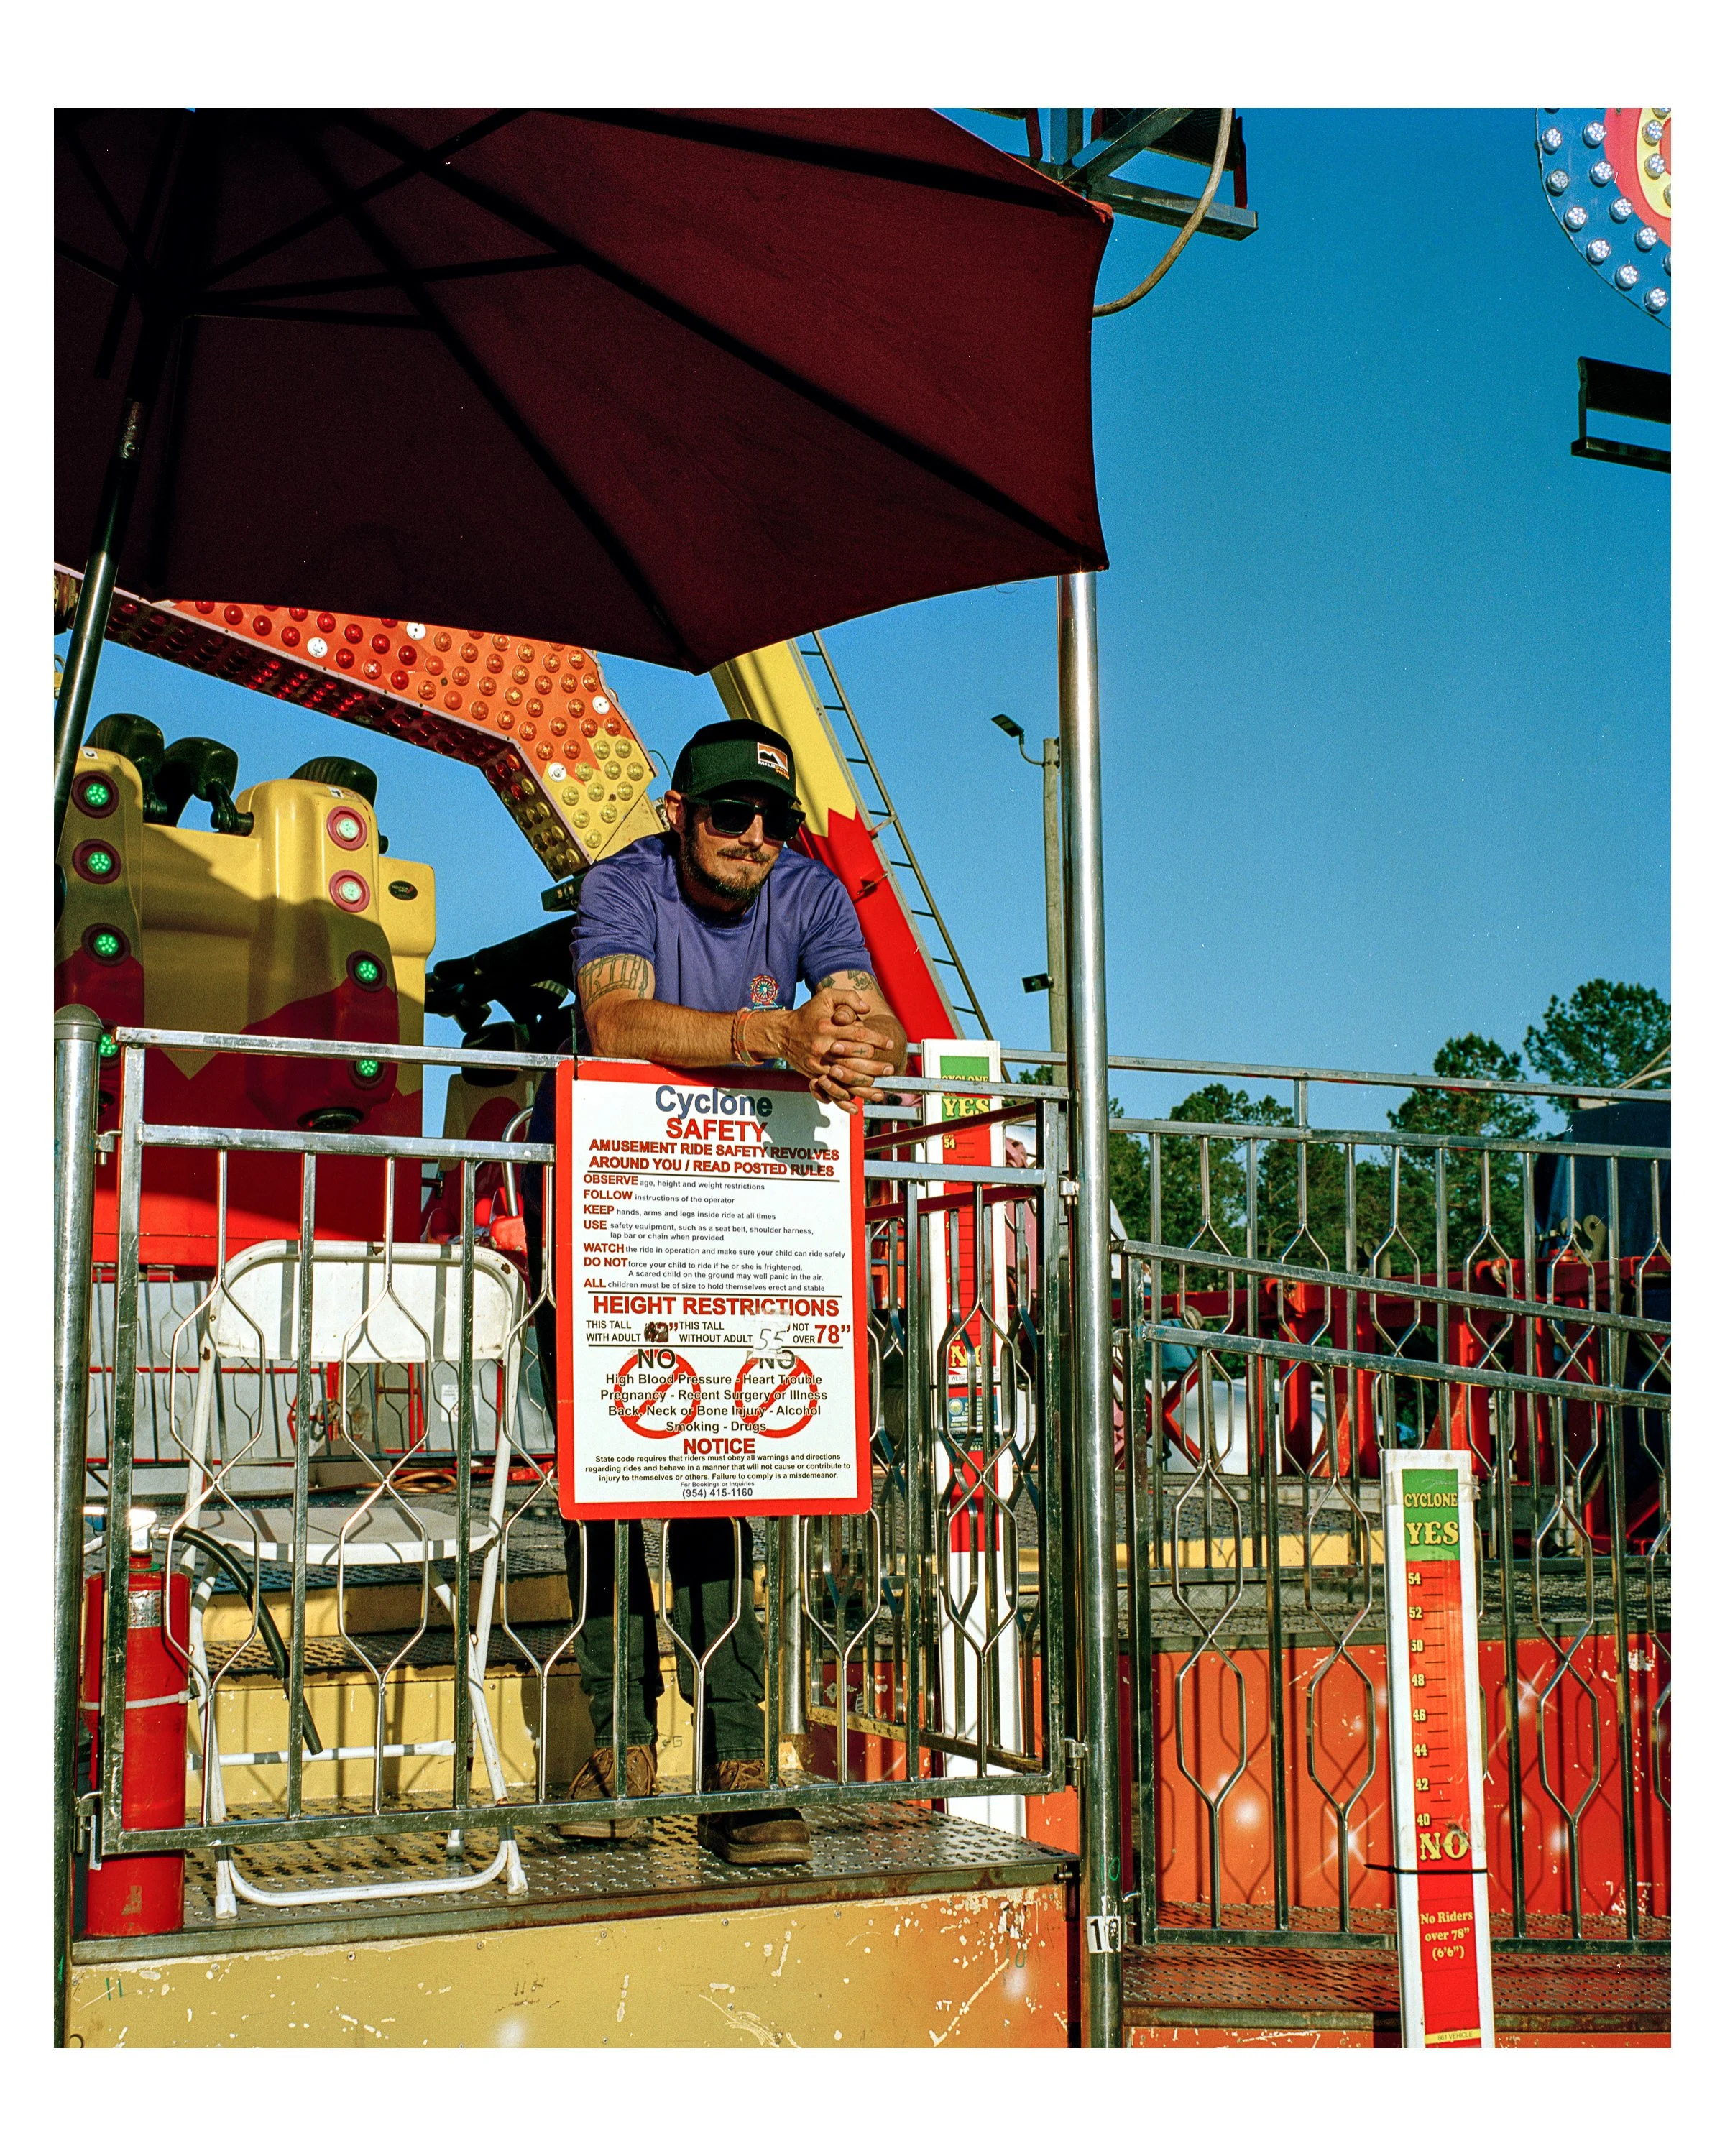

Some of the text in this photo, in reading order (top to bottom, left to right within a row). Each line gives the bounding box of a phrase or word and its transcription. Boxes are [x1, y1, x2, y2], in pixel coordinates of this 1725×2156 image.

[656, 1085, 773, 1120] Cyclone
[942, 1098, 990, 1116] YES
[666, 1118, 768, 1142] SAFETY
[589, 1139, 840, 1161] AMUSEMENT RIDE SAFETY REVOLVES
[944, 1138, 956, 1149] 54
[589, 1156, 649, 1170] AROUND
[653, 1158, 681, 1171] YOU
[694, 1161, 730, 1173] READ
[735, 1162, 787, 1175] POSTED
[791, 1164, 834, 1176] RULES
[584, 1174, 638, 1187] OBSERVE
[657, 1180, 681, 1189] height
[584, 1190, 632, 1201] FOLLOW
[584, 1205, 614, 1215] KEEP
[680, 1210, 695, 1219] legs
[584, 1220, 607, 1230] USE
[610, 1222, 633, 1232] safety
[635, 1224, 676, 1233] equipment,
[610, 1231, 622, 1240] lap
[584, 1257, 600, 1268] DO
[604, 1257, 627, 1268] NOT
[764, 1263, 803, 1272] frightened.
[584, 1278, 606, 1289] ALL
[594, 1295, 840, 1317] HEIGHT RESTRICTIONS
[586, 1319, 632, 1330] THIS TALL
[678, 1321, 724, 1330] THIS TALL
[793, 1322, 809, 1332] NOT
[586, 1332, 610, 1342] WITH
[611, 1333, 641, 1342] ADULT
[678, 1333, 753, 1343] WITHOUT ADULT
[793, 1335, 815, 1344] OVER
[638, 1348, 676, 1369] NO
[606, 1373, 822, 1387] High Blood Pressure Heart Trouble
[601, 1389, 666, 1403] Pregnancy
[678, 1389, 720, 1400] Recent
[724, 1389, 770, 1403] Surgery
[790, 1389, 827, 1400] Illness
[608, 1406, 643, 1417] Back,
[647, 1405, 677, 1416] Neck
[697, 1405, 728, 1416] Bone
[732, 1405, 765, 1418] Injury
[776, 1405, 821, 1415] Alcohol
[666, 1421, 766, 1434] Smoking Drugs
[683, 1437, 756, 1455] NOTICE
[636, 1455, 667, 1463] requires
[684, 1453, 707, 1462] riders
[727, 1454, 745, 1462] obey
[746, 1452, 755, 1461] all
[682, 1488, 753, 1499] (954) 415-1160
[1404, 1493, 1458, 1508] CYCLONE
[1405, 1521, 1459, 1545] YES
[1408, 1572, 1422, 1585] 54
[1409, 1606, 1422, 1619] 52
[1411, 1639, 1424, 1652] 50
[1412, 1674, 1425, 1687] 48
[1412, 1708, 1427, 1721] 46
[1414, 1744, 1427, 1757] 44
[1415, 1777, 1430, 1792] 42
[1417, 1812, 1430, 1827] 40
[1420, 1830, 1469, 1861] NO
[1420, 1911, 1473, 1925] No Riders
[1425, 1930, 1449, 1942] over
